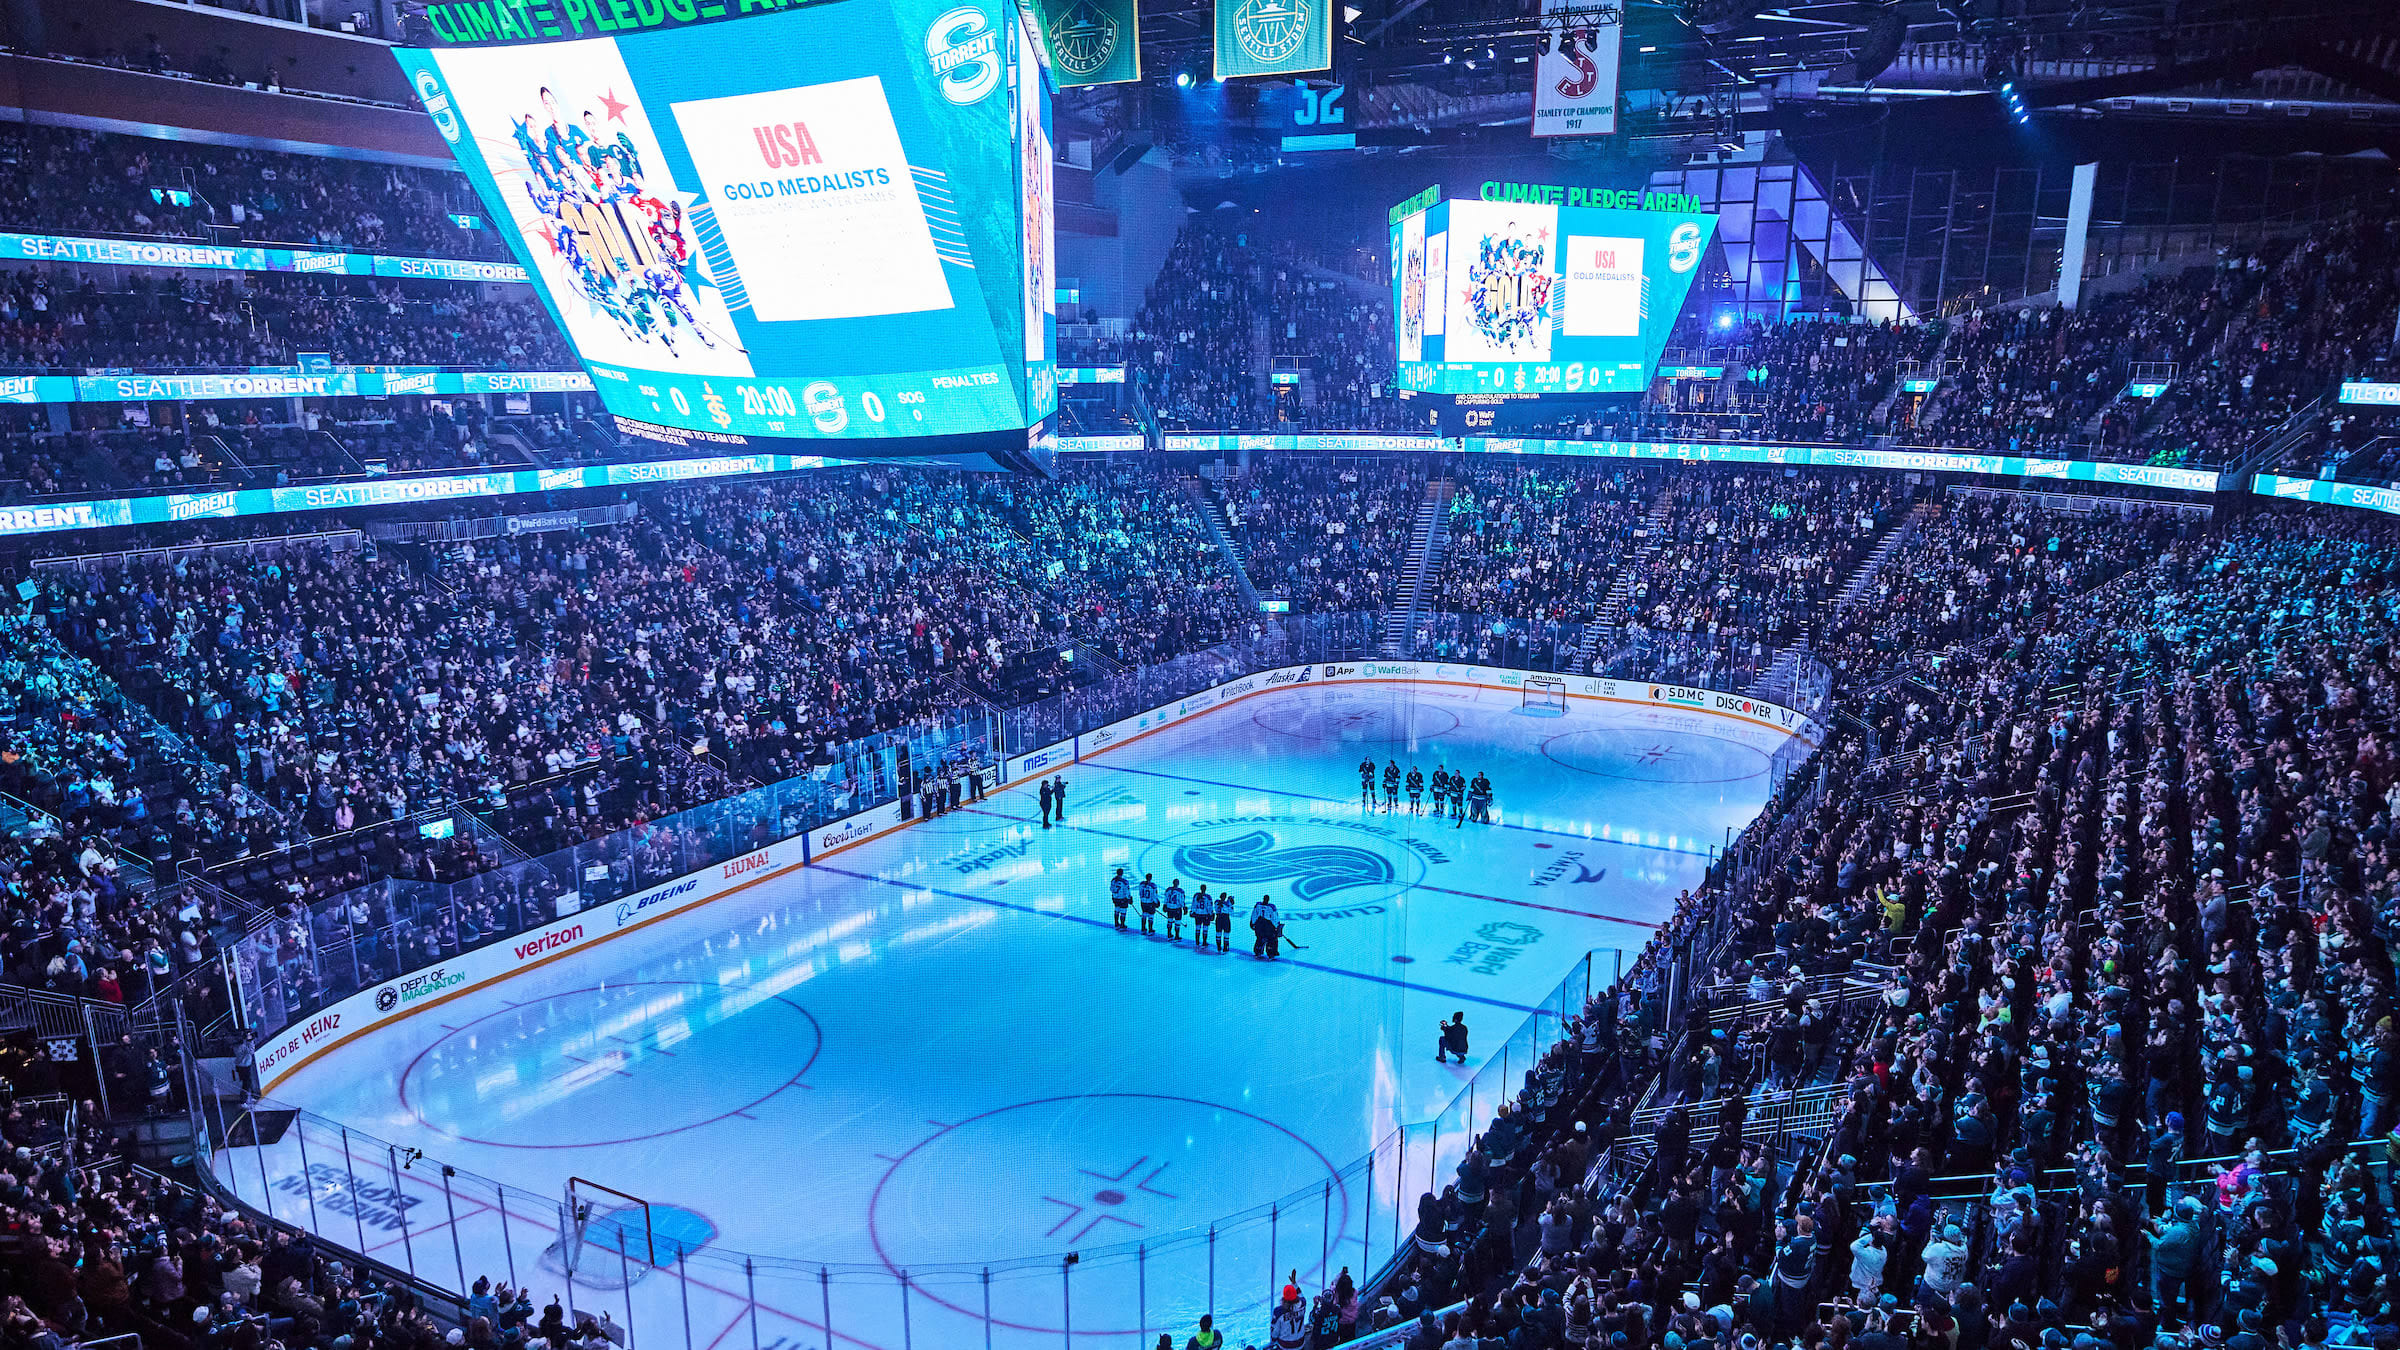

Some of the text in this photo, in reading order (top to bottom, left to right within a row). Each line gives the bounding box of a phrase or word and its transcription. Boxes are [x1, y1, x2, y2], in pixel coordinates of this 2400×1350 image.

[427, 0, 562, 43] CLIMATE
[1239, 12, 1305, 57] SEATTLE STORM
[930, 29, 997, 76] TORRENT
[1092, 27, 1113, 67] STORM
[1537, 105, 1613, 118] STANLEY CUP CHAMPIONS
[1566, 119, 1582, 129] 1917
[753, 121, 823, 170] USA
[724, 167, 890, 201] GOLD MEDALISTS
[1481, 181, 1702, 214] CLIMATE PLEDGE ARENA
[21, 238, 237, 266] SEATTLE TORRENT
[1594, 250, 1616, 269] USA
[294, 253, 346, 272] TORRENT
[400, 260, 530, 280] SEATTLE TORRE
[1573, 272, 1635, 282] GOLD MEDALISTS
[488, 375, 553, 390] SEATTLE
[932, 371, 999, 390] PENALTIES
[1535, 366, 1560, 384] 20:00
[1676, 369, 1707, 378] TORRENT
[117, 377, 327, 397] SEATTLE TORRENT
[385, 373, 436, 395] TORRENT
[2341, 385, 2375, 401] TTLE
[669, 387, 690, 416] 0
[736, 385, 797, 416] 20:00
[897, 390, 926, 404] SOG
[862, 391, 886, 423] 0
[913, 409, 923, 421] 0
[1479, 410, 1495, 419] WaFd
[664, 434, 690, 447] GOLD.
[692, 430, 705, 441] TO
[703, 431, 729, 444] TEAM
[727, 435, 749, 446] USA
[1059, 437, 1110, 450] SEATTLE
[1240, 437, 1276, 449] TORRENT
[1317, 437, 1444, 450] SEATTLE TORRENT
[1486, 438, 1525, 451] TORRENT
[630, 458, 756, 480] SEATTLE TORRENT
[1834, 451, 1982, 470] SEATTLE TORRENT
[2025, 460, 2073, 476] TORRENT
[2117, 467, 2178, 484] SEATTLE
[305, 477, 489, 506] SEATTLE TORRENT
[169, 493, 237, 521] TORRENT
[560, 516, 578, 524] CLUB
[1265, 671, 1296, 686] Alaska
[1530, 674, 1562, 683] amazon
[1226, 680, 1255, 698] PitchBook
[1668, 687, 1705, 701] SDMC
[1716, 696, 1771, 719] DISCOVER
[823, 823, 873, 849] Coors LIGHT
[1192, 815, 1452, 866] CLIMATE PLEDGE ARENA
[723, 851, 770, 880] LiUNA!
[1528, 850, 1585, 889] SYMETRA
[637, 879, 698, 910] BOEING
[1280, 905, 1386, 921] CLIMAT
[514, 924, 584, 960] verizon
[401, 968, 445, 992] DEPT OF
[402, 971, 465, 1003] IMAGINATION
[259, 1053, 276, 1075] HAS
[275, 1046, 287, 1062] TO
[288, 1037, 299, 1054] BE
[301, 1013, 341, 1044] HEINZ
